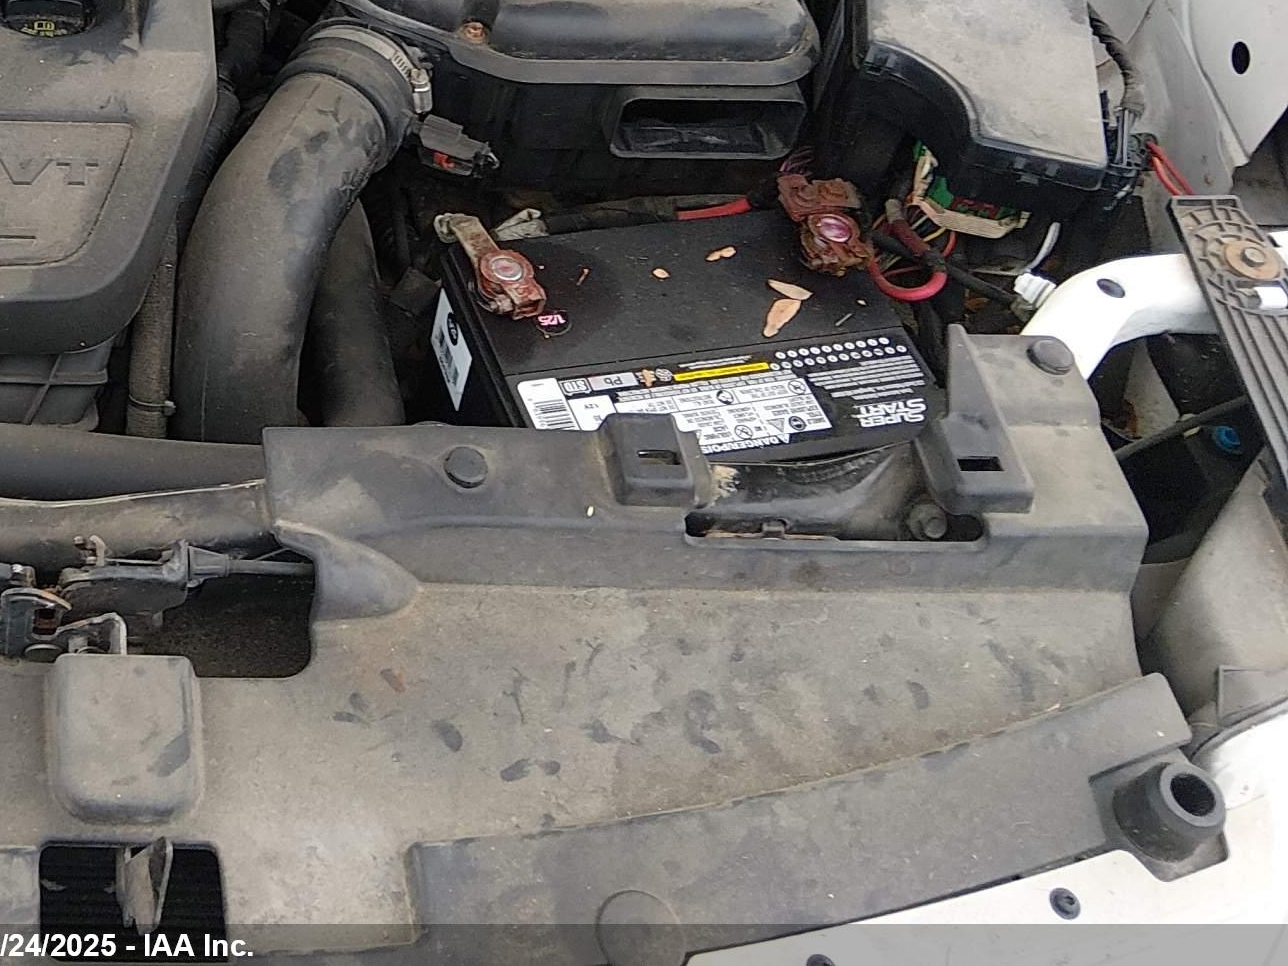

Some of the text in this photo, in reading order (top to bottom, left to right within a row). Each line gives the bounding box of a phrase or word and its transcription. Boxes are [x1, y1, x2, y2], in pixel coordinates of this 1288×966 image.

[603, 376, 623, 386] Pb
[857, 398, 927, 415] START
[859, 414, 925, 428] SUPER
